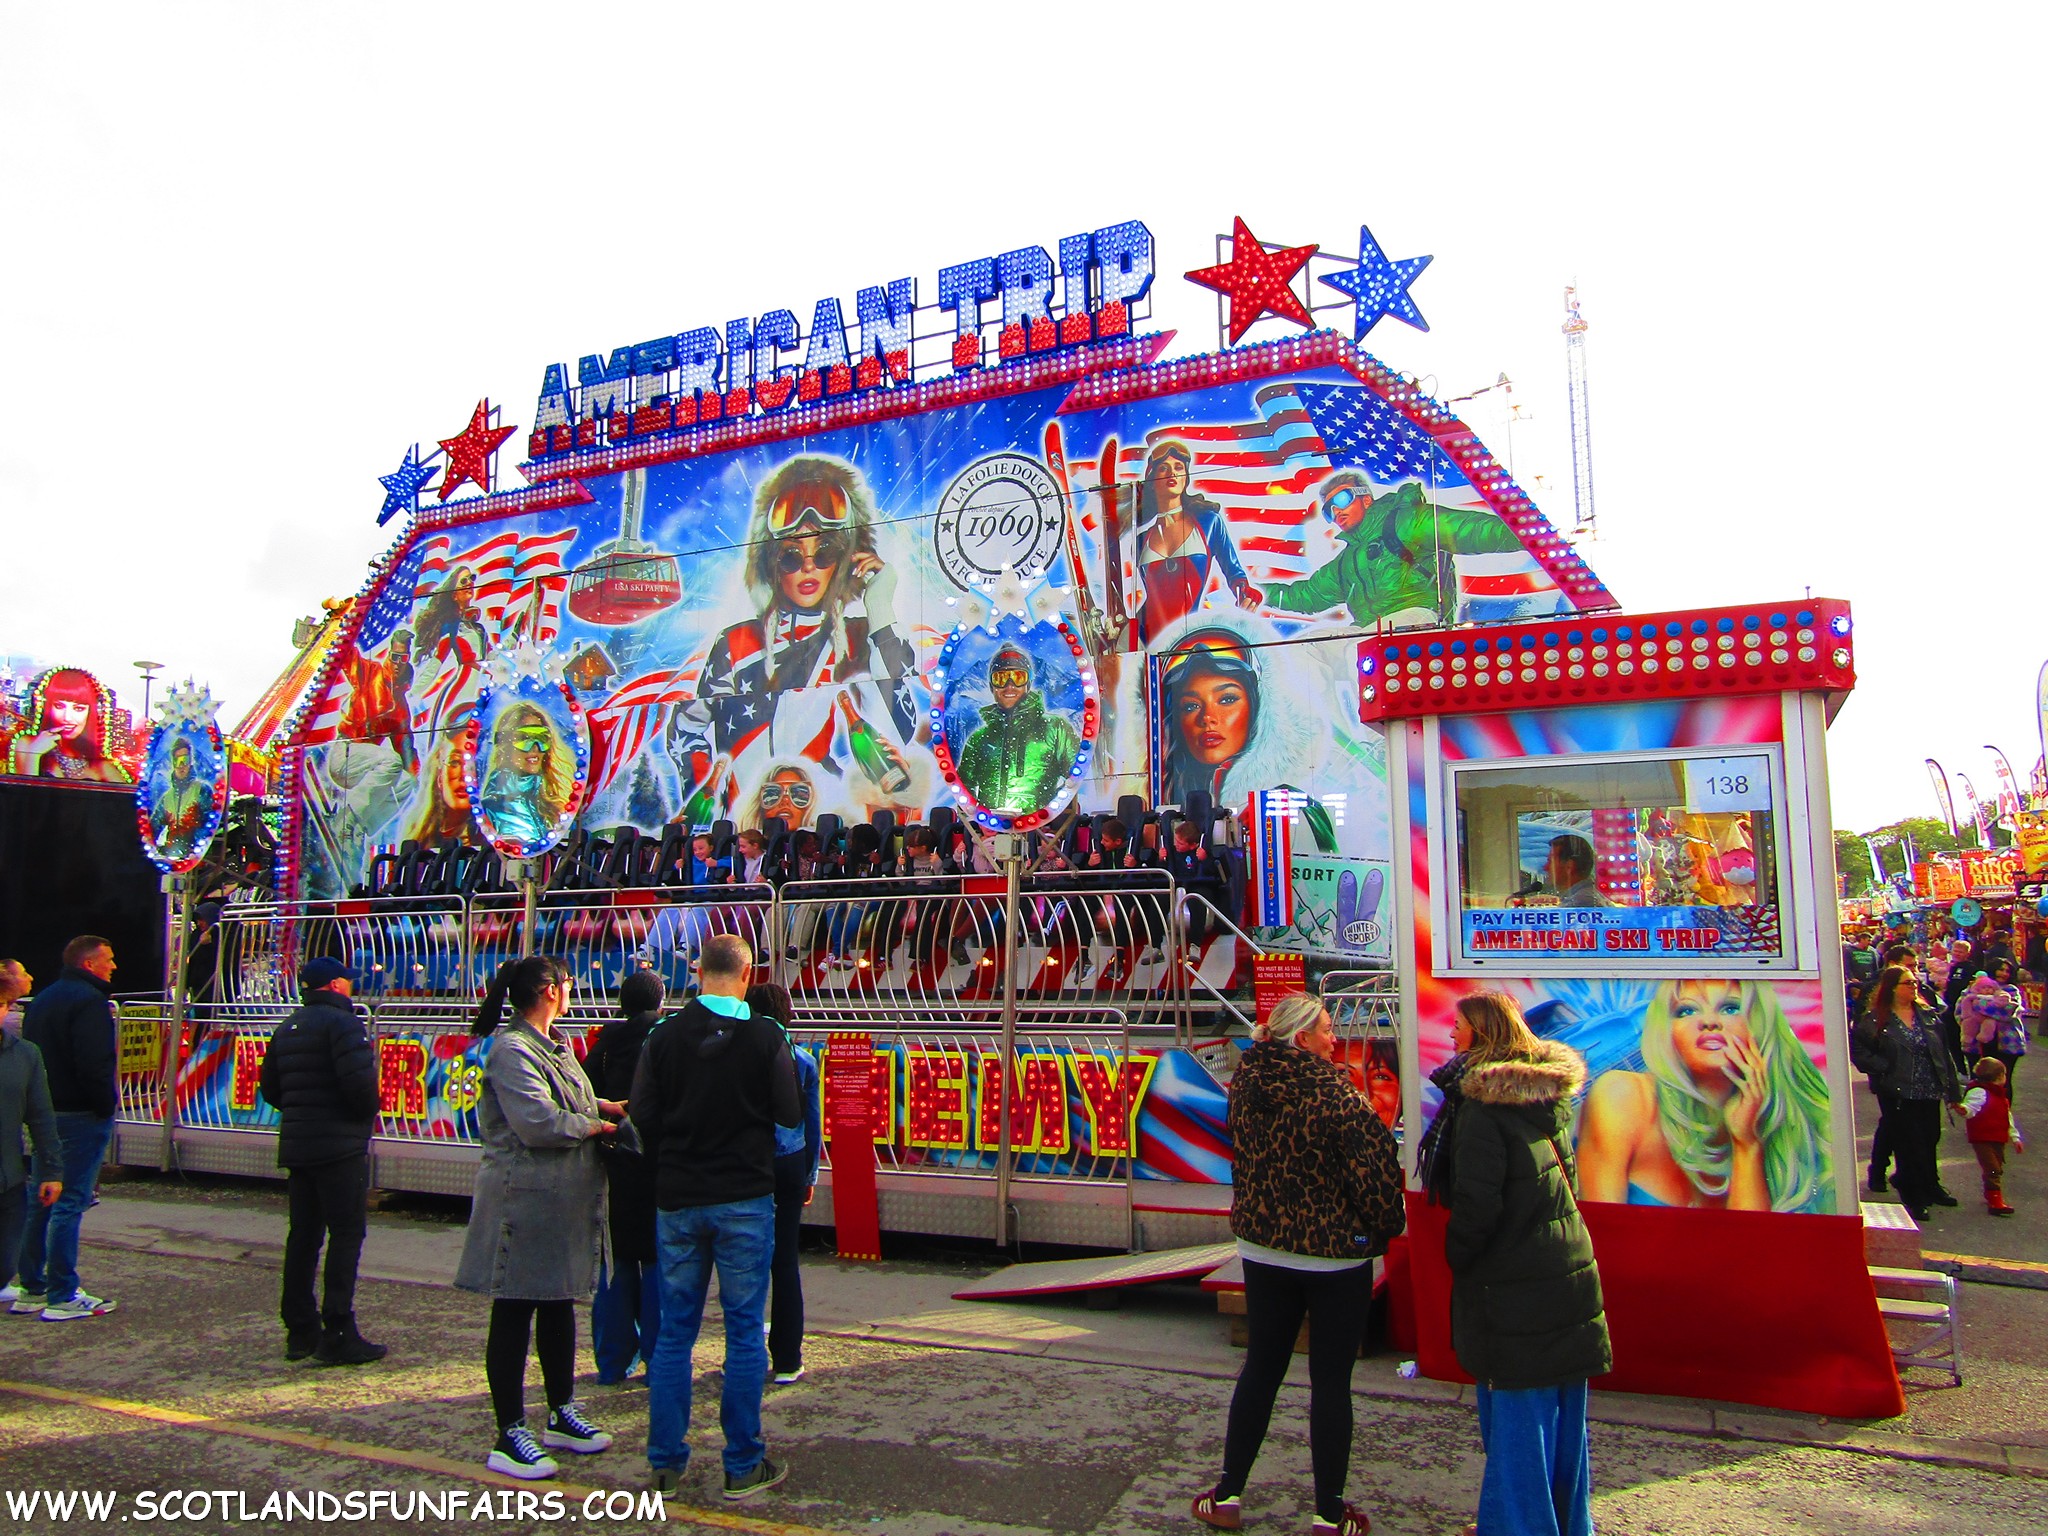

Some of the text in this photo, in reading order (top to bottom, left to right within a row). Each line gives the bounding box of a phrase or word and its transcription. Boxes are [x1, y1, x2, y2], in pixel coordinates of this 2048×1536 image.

[528, 220, 1156, 458] AMERICAN TRIP
[951, 463, 1054, 505] LA FOLIE DOUCE
[965, 505, 1034, 548] 1969
[945, 548, 960, 569] LA
[615, 583, 629, 591] USA
[630, 584, 644, 592] SKI
[1706, 775, 1749, 795] 138
[1265, 815, 1275, 899] AMERICAN TRIP
[1346, 922, 1375, 933] WINTER
[1472, 912, 1620, 925] PAY HERE FOR...
[1348, 932, 1375, 943] SPORT
[1470, 928, 1720, 950] AMERICAN SKI TRIP
